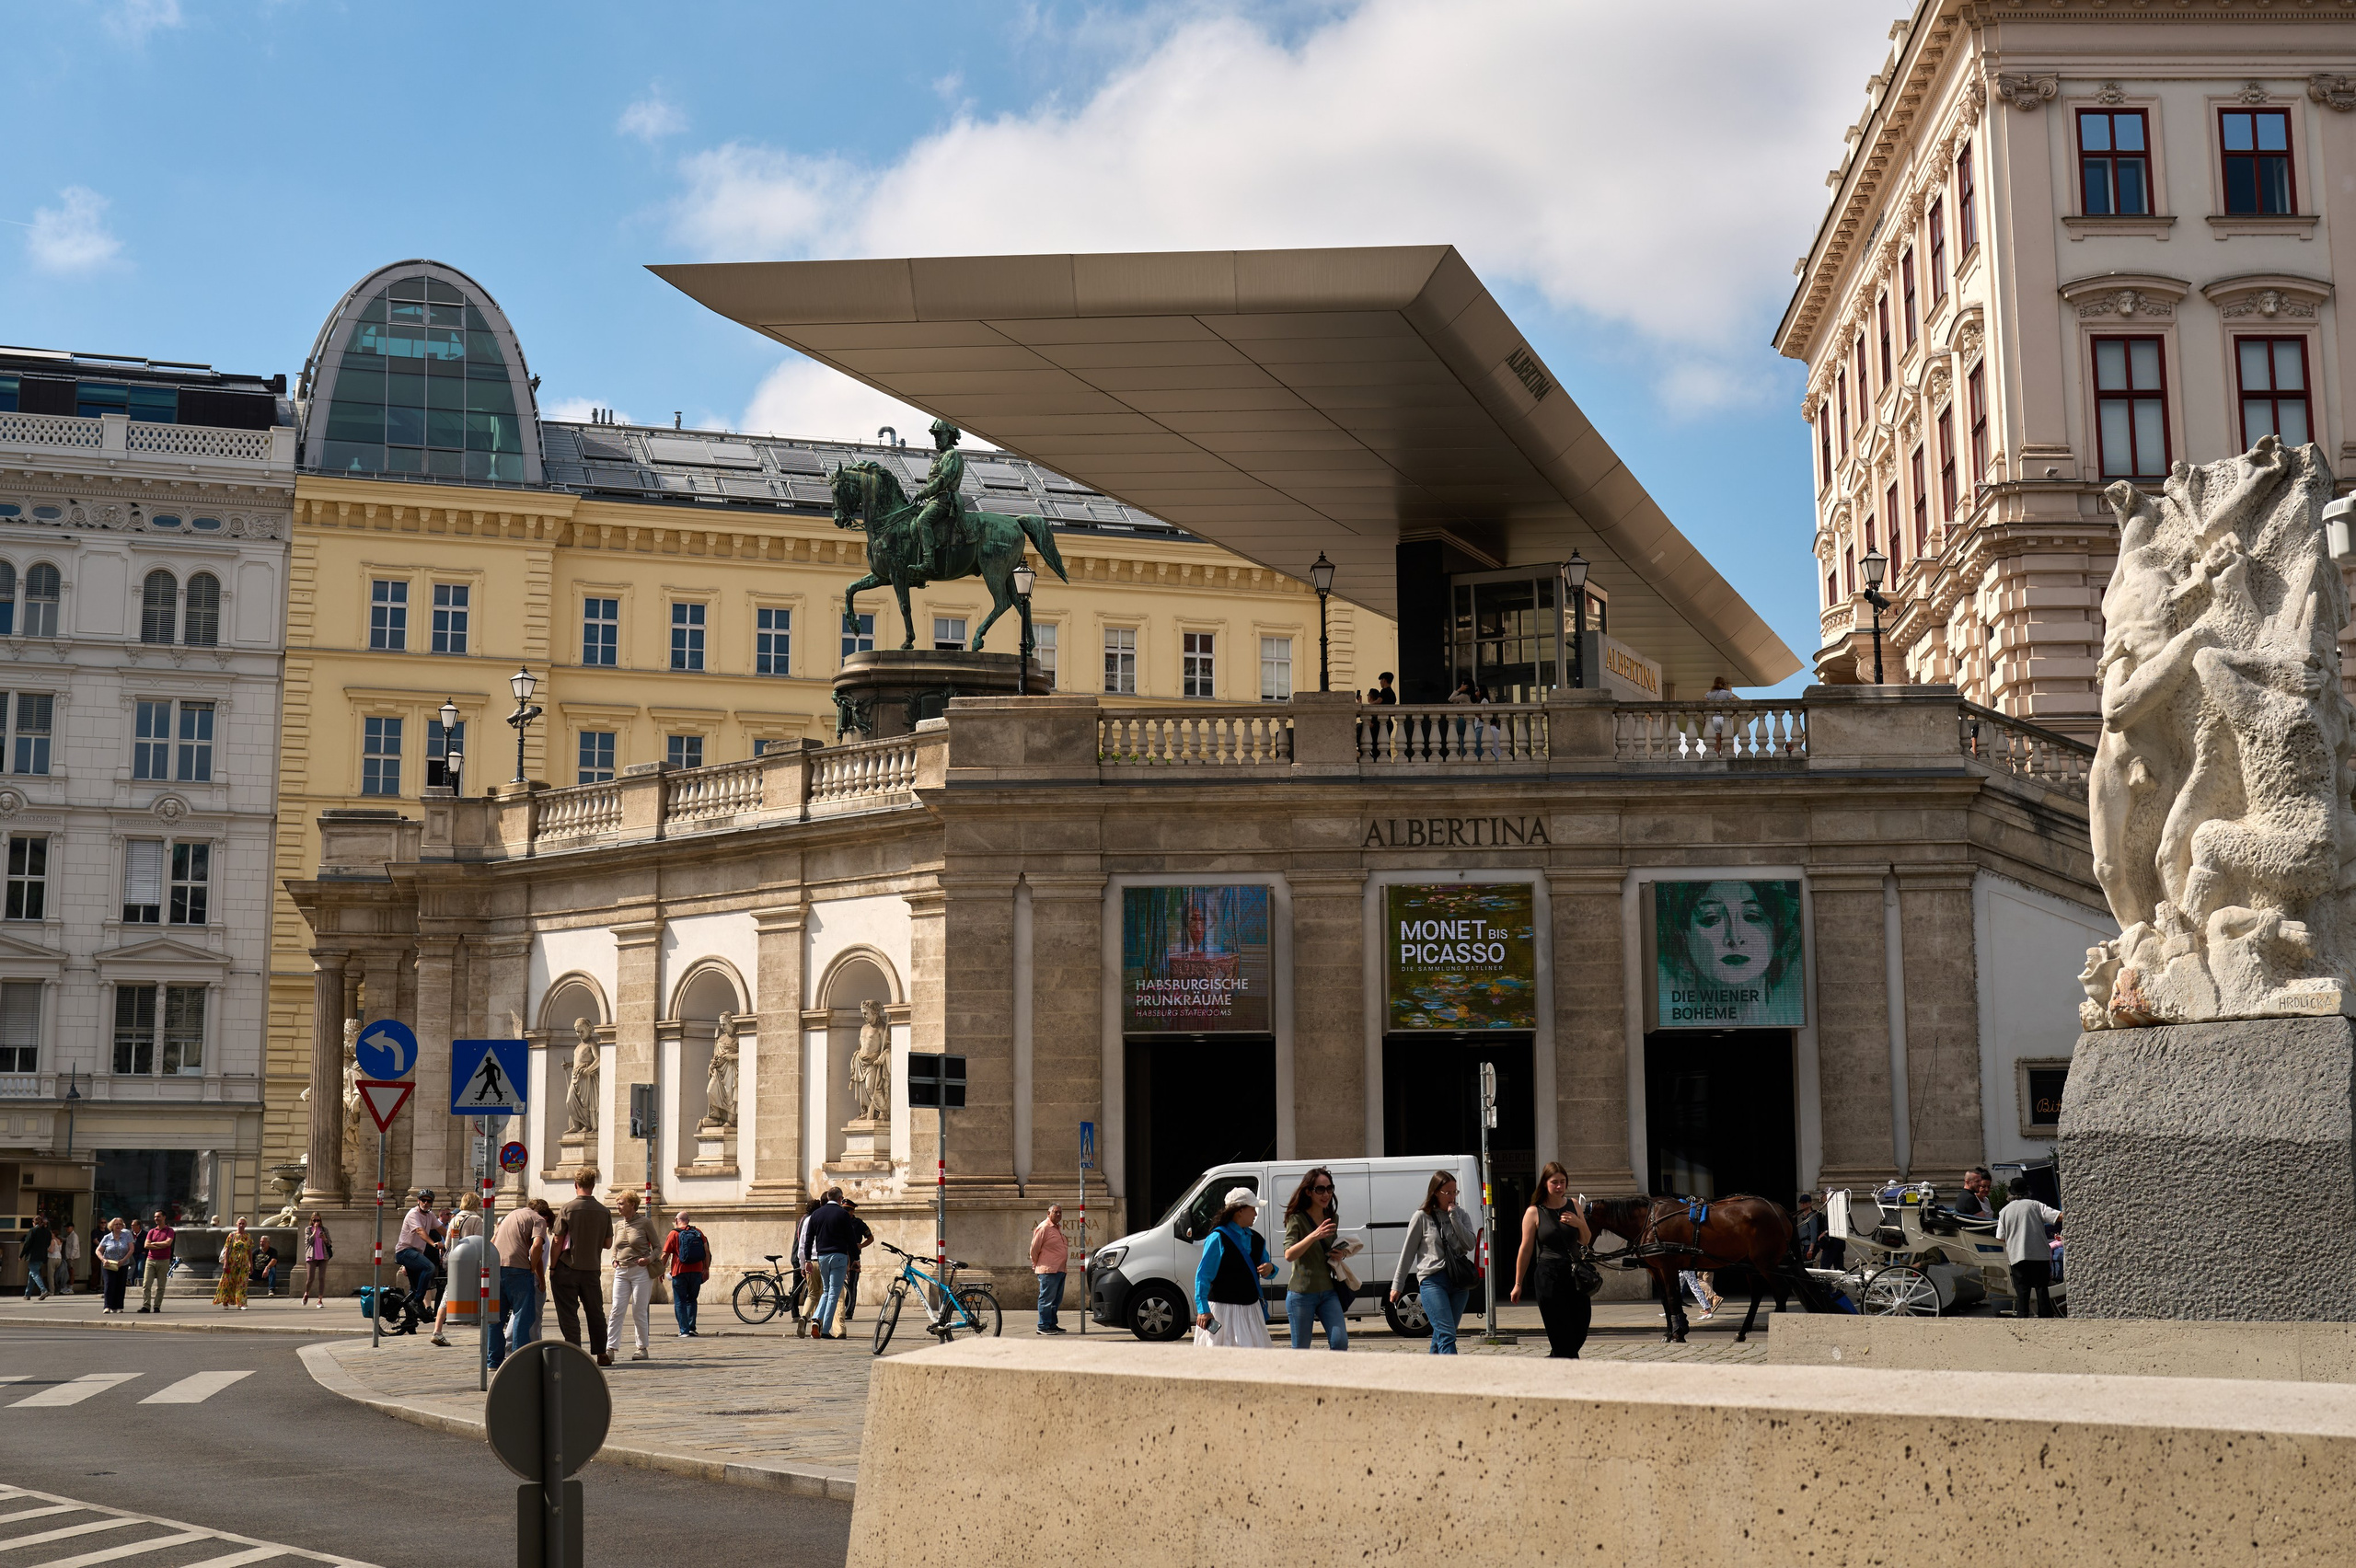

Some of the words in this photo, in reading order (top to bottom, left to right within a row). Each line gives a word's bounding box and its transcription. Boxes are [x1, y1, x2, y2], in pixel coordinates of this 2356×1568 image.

[1505, 347, 1553, 402] ALBERTINA
[1606, 646, 1657, 694] ALBERTINA
[1361, 816, 1552, 847] ALBERTINA
[1401, 920, 1487, 940] MONET
[1488, 928, 1508, 940] BIS
[1401, 942, 1506, 964] PICASSO
[1136, 978, 1249, 991] HABSBURGISCHE
[1136, 991, 1232, 1006] PRUNKRÄUME
[1671, 990, 1695, 1003] DIE
[1700, 989, 1760, 1002] WIENER
[1179, 1009, 1232, 1017] STATEROOMS
[1672, 1004, 1737, 1020] BOHÈME
[2037, 1098, 2062, 1113] Bit
